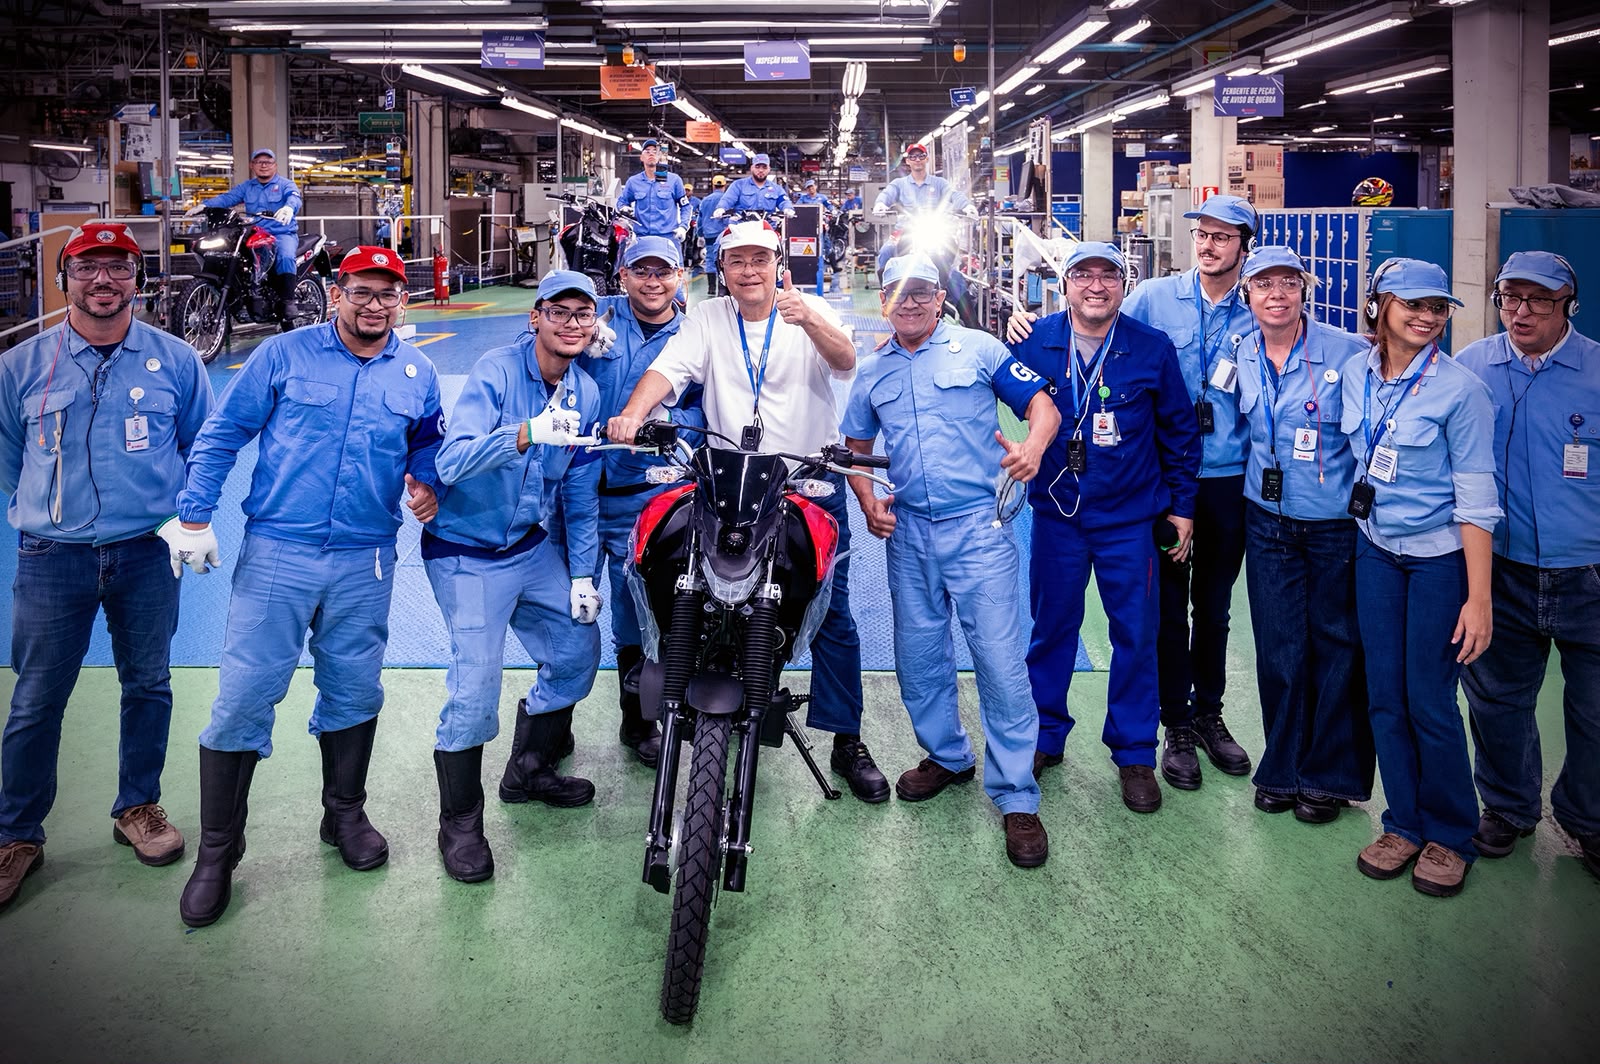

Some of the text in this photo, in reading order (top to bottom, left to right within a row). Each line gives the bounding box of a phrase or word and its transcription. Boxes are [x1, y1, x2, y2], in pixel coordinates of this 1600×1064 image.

[755, 55, 799, 65] INSPEÇÃO VISUAL
[1222, 87, 1276, 96] PENDENTE DE PEÇAS
[1221, 96, 1276, 104] DE AVISO DE QUEBRA
